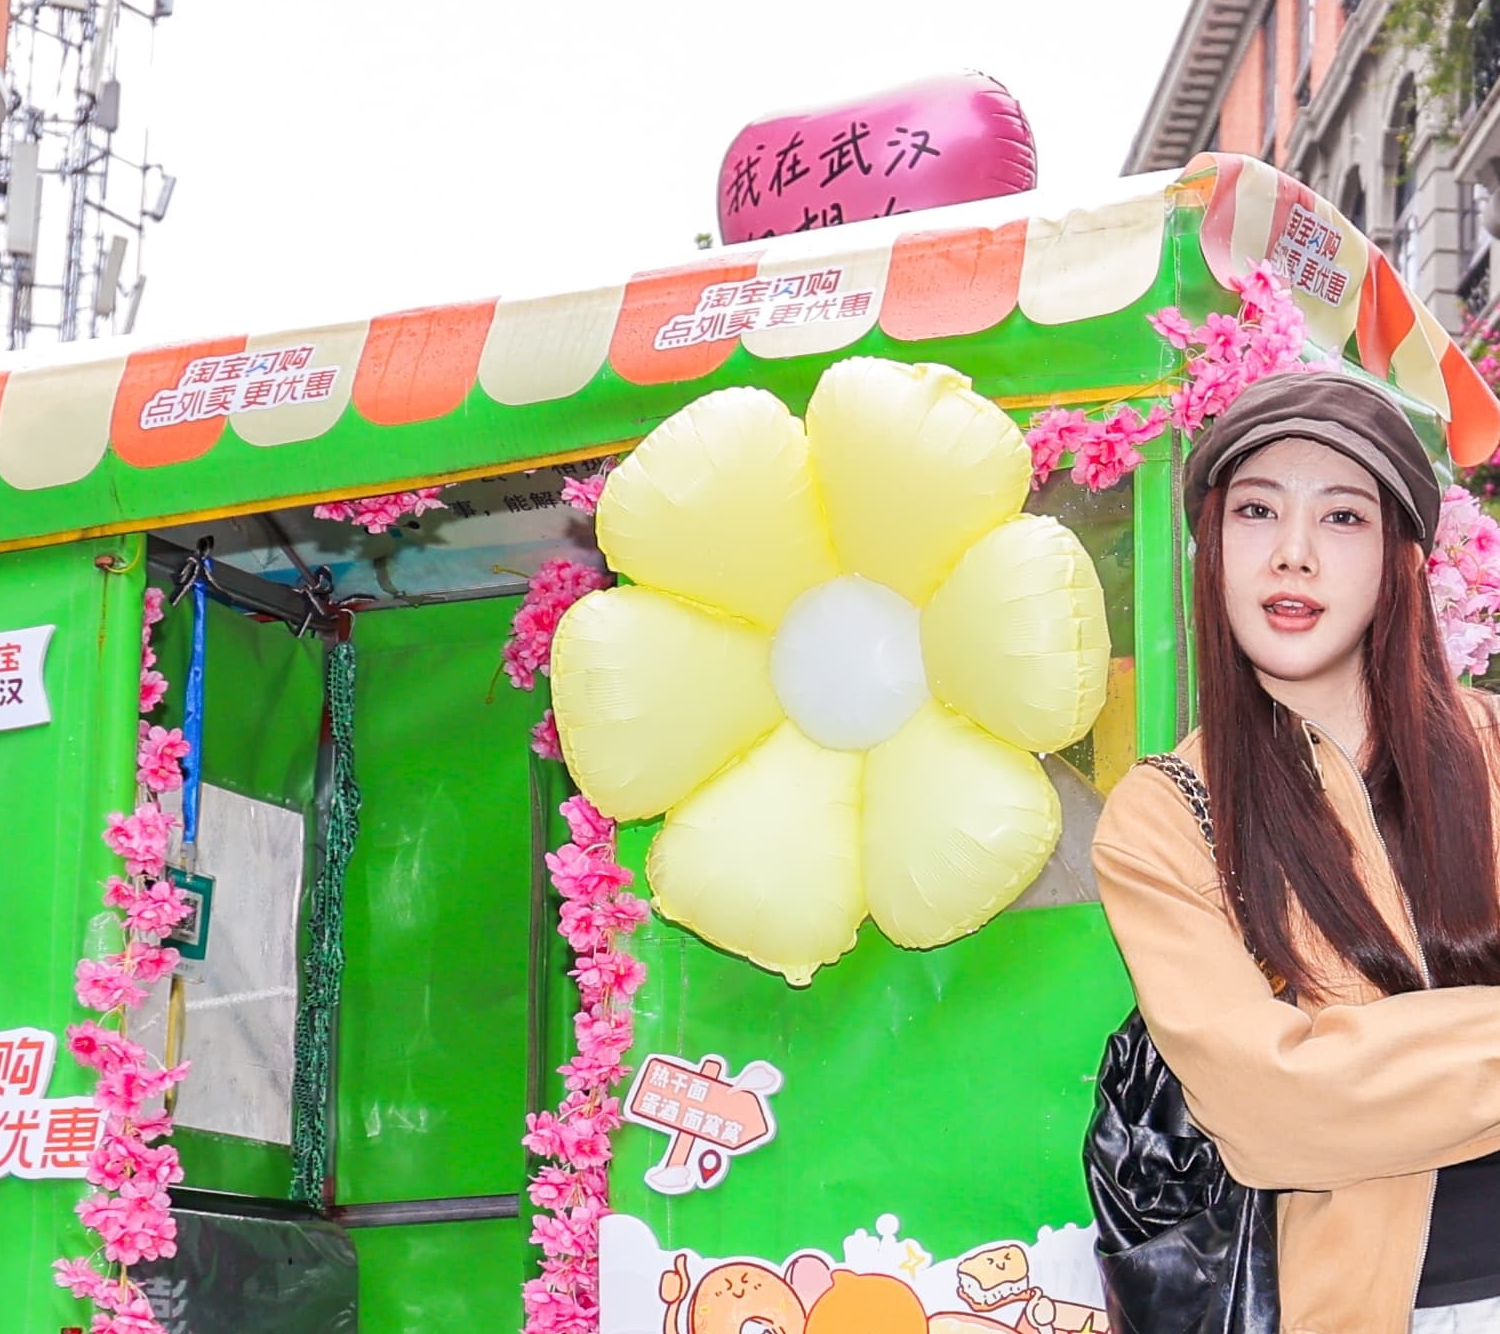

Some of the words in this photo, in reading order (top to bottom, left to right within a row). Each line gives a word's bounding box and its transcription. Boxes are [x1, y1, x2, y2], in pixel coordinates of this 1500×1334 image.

[726, 121, 941, 216] 我在武汉
[700, 268, 843, 312] 淘宝闪购
[658, 307, 760, 347] 点外卖
[766, 291, 873, 328] 更优惠
[183, 346, 314, 386] 淘宝闪购
[144, 384, 236, 425] 点外卖
[240, 370, 337, 409] 更优惠
[649, 1064, 710, 1103] 热干面
[639, 1092, 680, 1123] 蛋酒
[682, 1106, 743, 1144] 面窝窝
